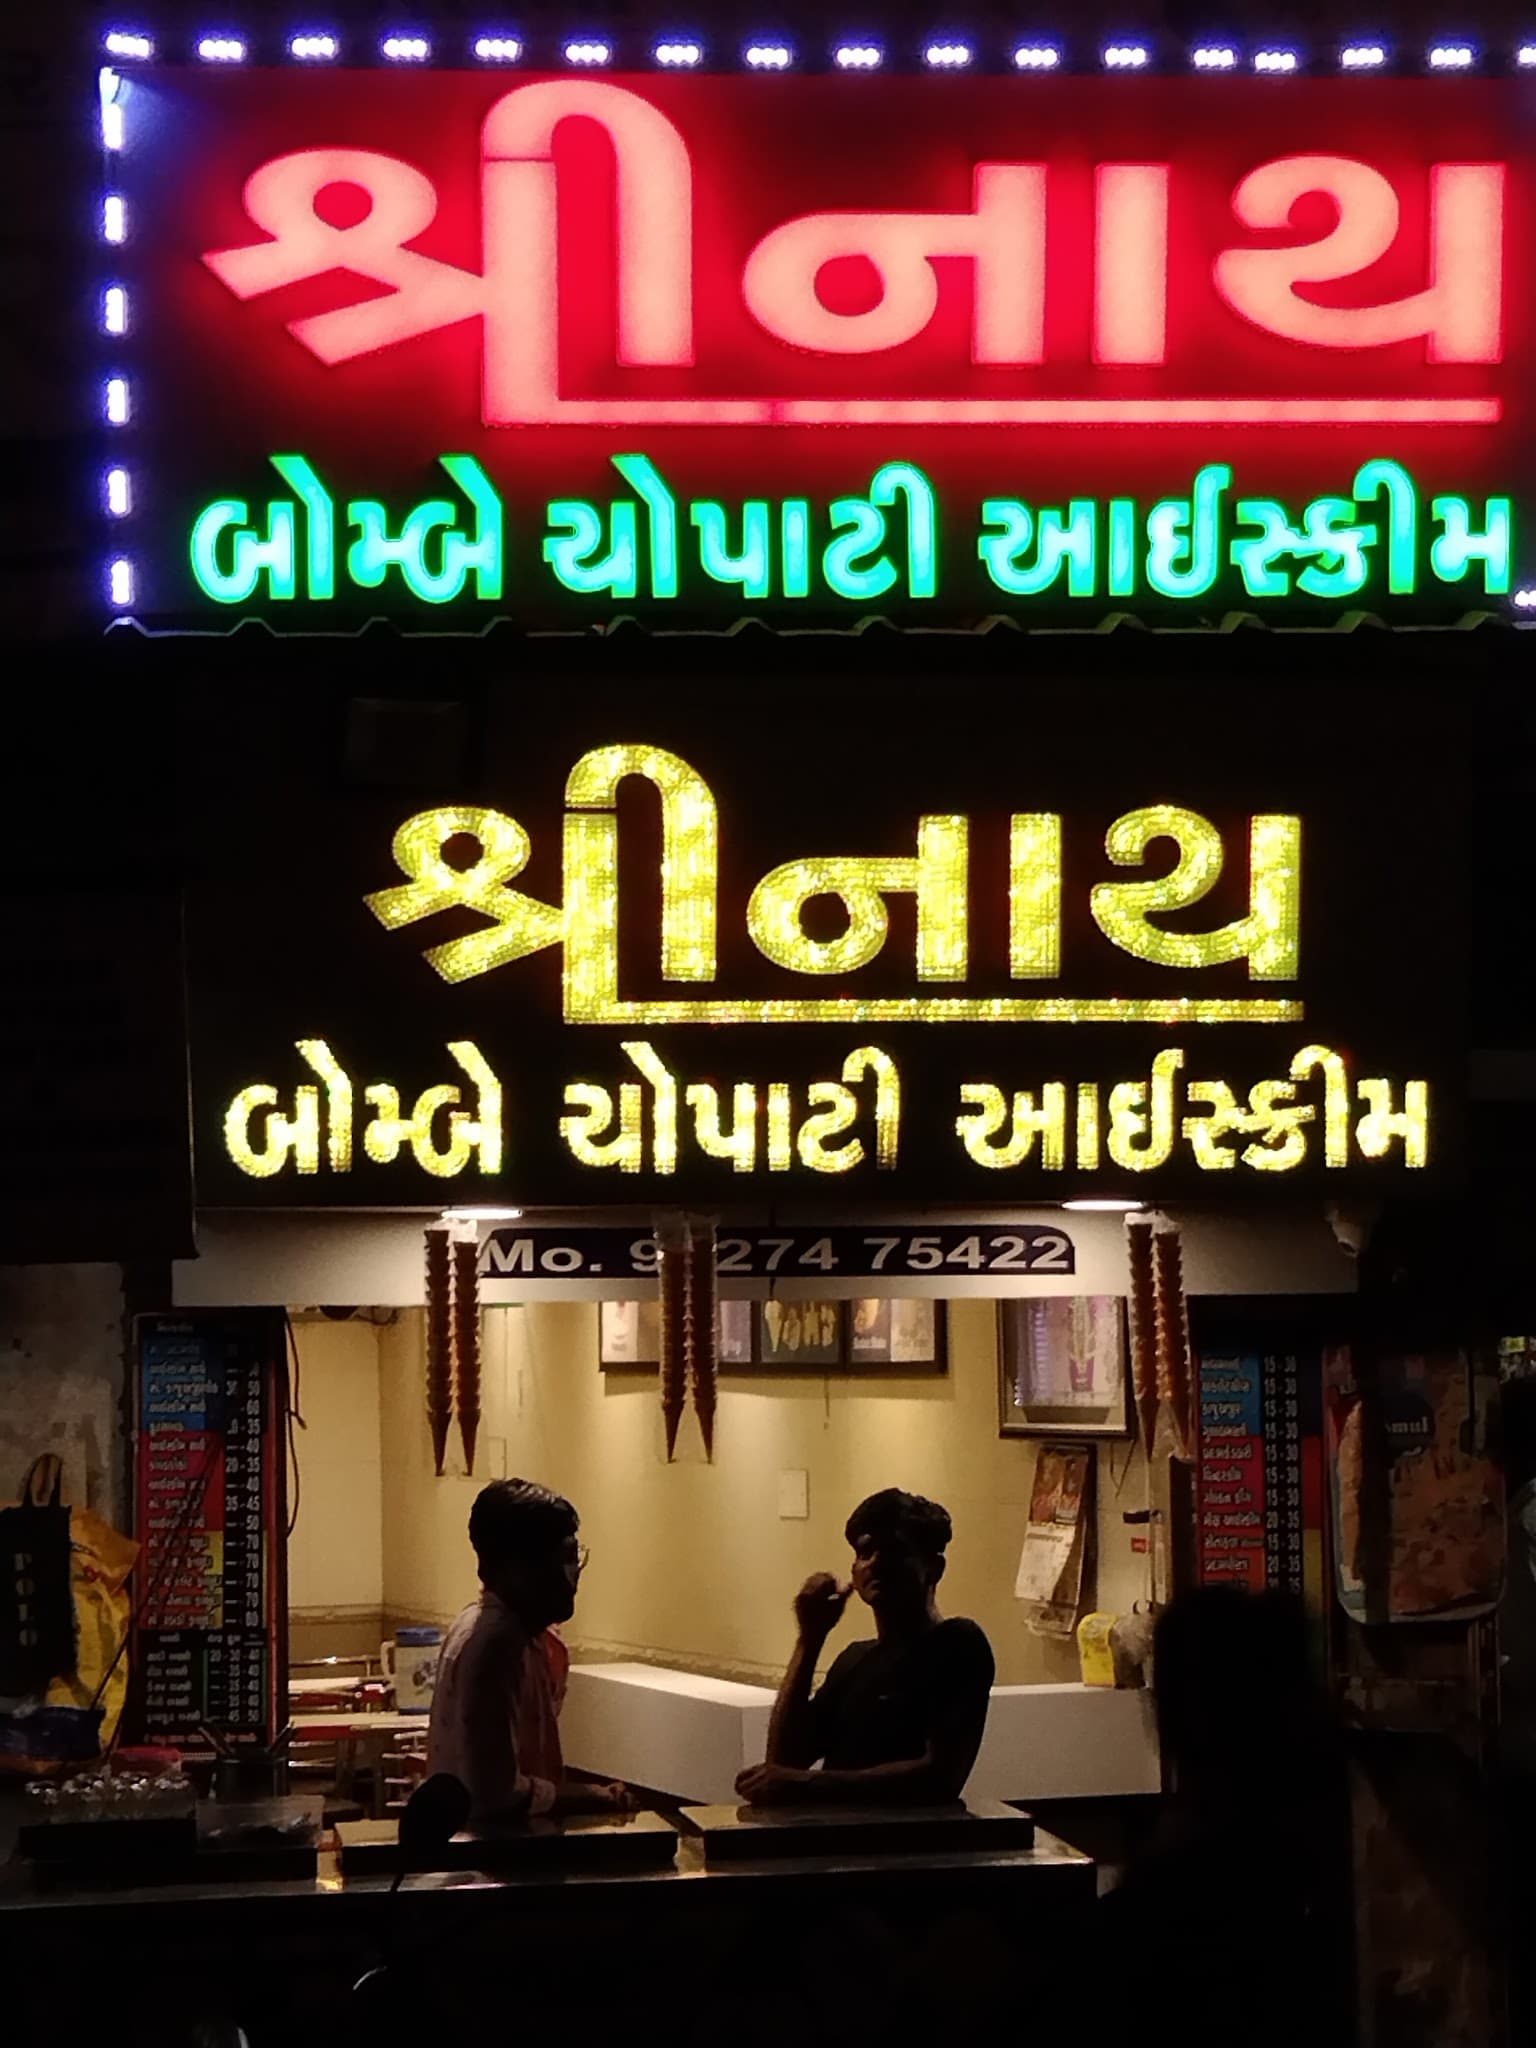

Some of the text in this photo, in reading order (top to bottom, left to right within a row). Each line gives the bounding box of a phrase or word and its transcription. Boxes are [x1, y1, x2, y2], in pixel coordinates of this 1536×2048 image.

[203, 77, 1506, 427] શ્રીનાથ
[190, 454, 1513, 604] બોમ્બે ચોપાટી આઈસ્ક્રીમ
[364, 744, 1304, 1026] શ્રીનાથ
[223, 1038, 502, 1179] બોમ્બે
[558, 1041, 901, 1176] ચોપાટી
[480, 1236, 1070, 1273] Mo. 9274 75422
